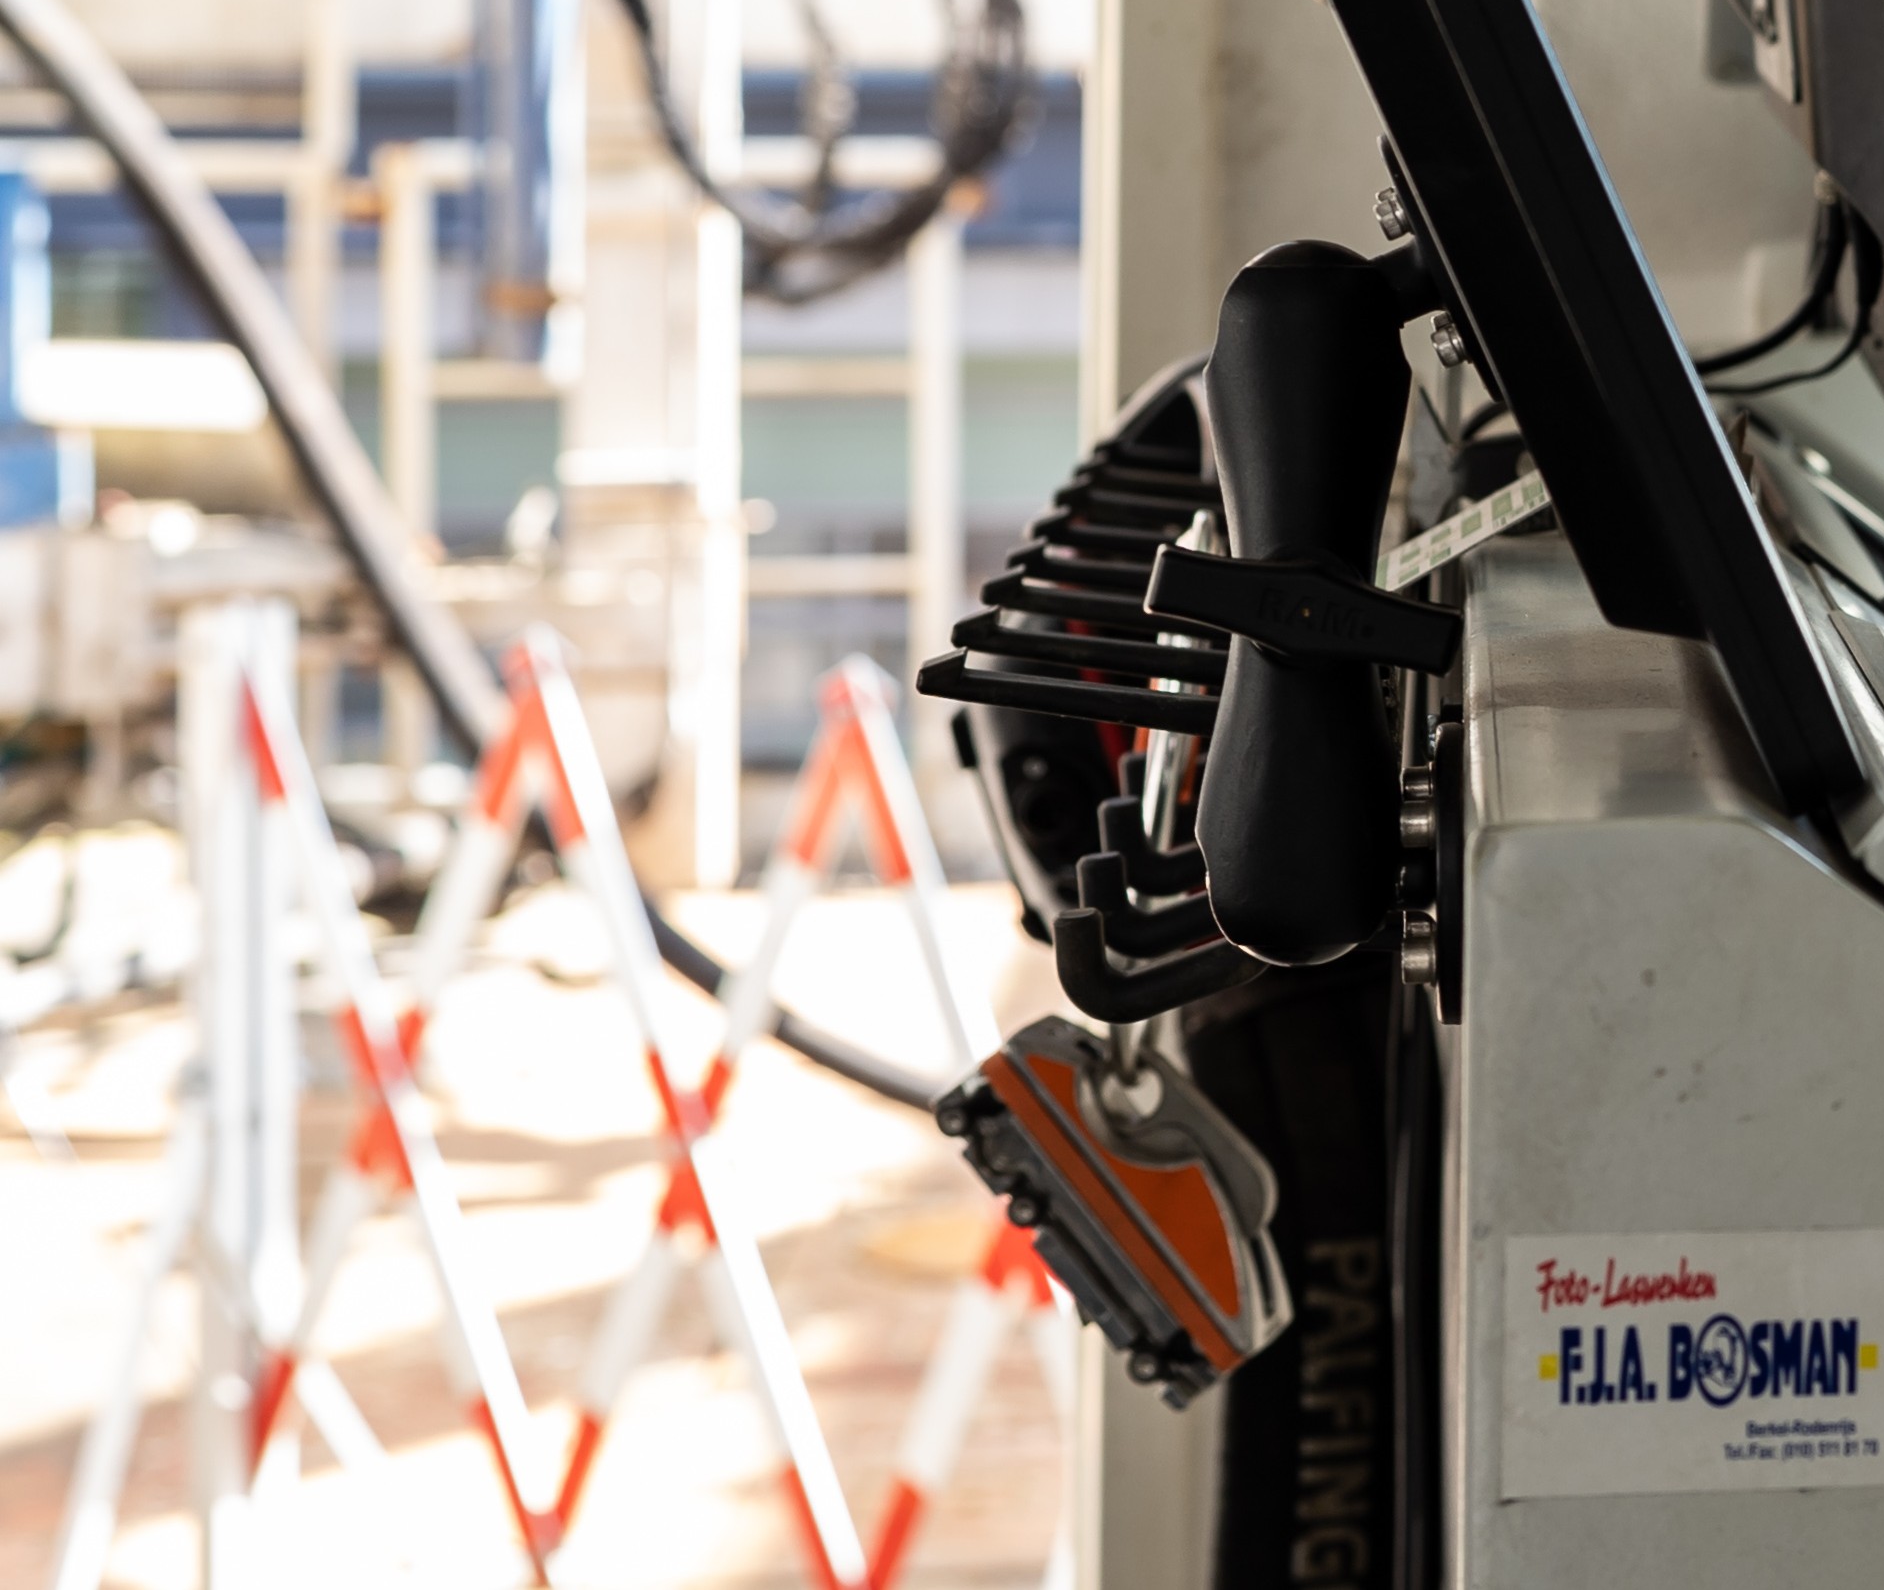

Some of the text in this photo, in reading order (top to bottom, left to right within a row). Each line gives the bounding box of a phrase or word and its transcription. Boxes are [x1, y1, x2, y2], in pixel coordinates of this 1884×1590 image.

[1291, 1236, 1381, 1590] PALFING
[1559, 1313, 1859, 1408] F.J.A. BOSMAN
